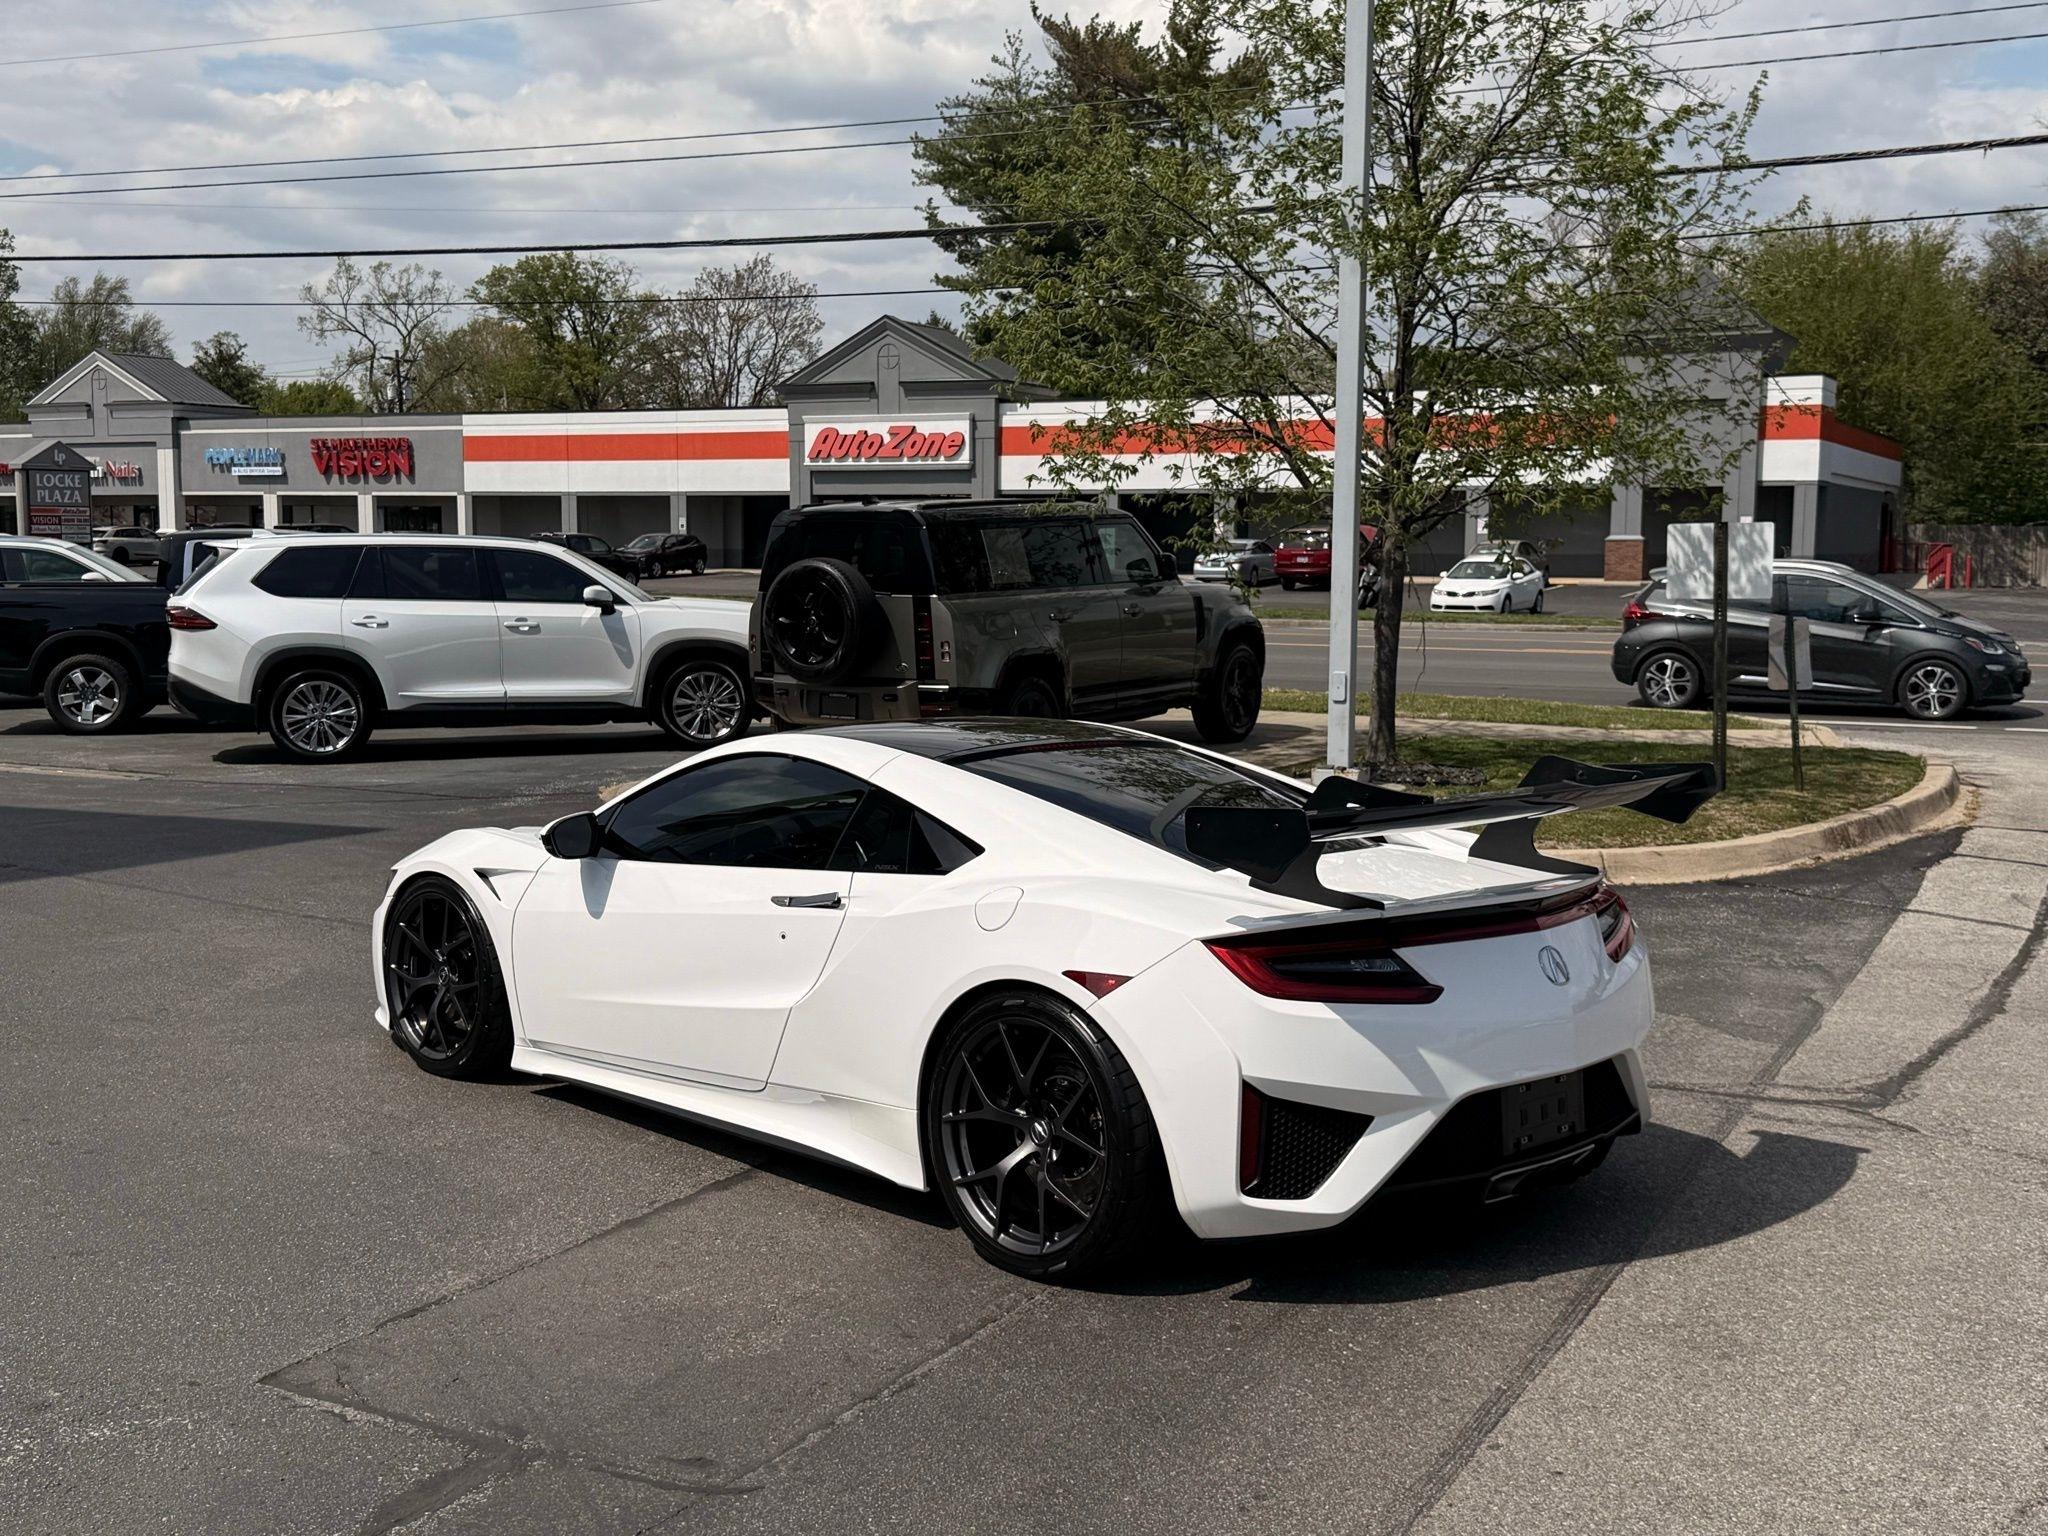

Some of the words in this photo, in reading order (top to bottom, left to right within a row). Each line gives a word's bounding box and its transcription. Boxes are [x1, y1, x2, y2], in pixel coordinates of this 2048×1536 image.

[331, 438, 408, 451] MATTHEWS
[807, 425, 964, 459] AutoZone
[105, 459, 139, 477] Nails
[311, 450, 410, 476] VISION
[36, 473, 82, 488] LOCKE
[37, 489, 82, 503] PLAZA
[32, 516, 59, 525] VISION
